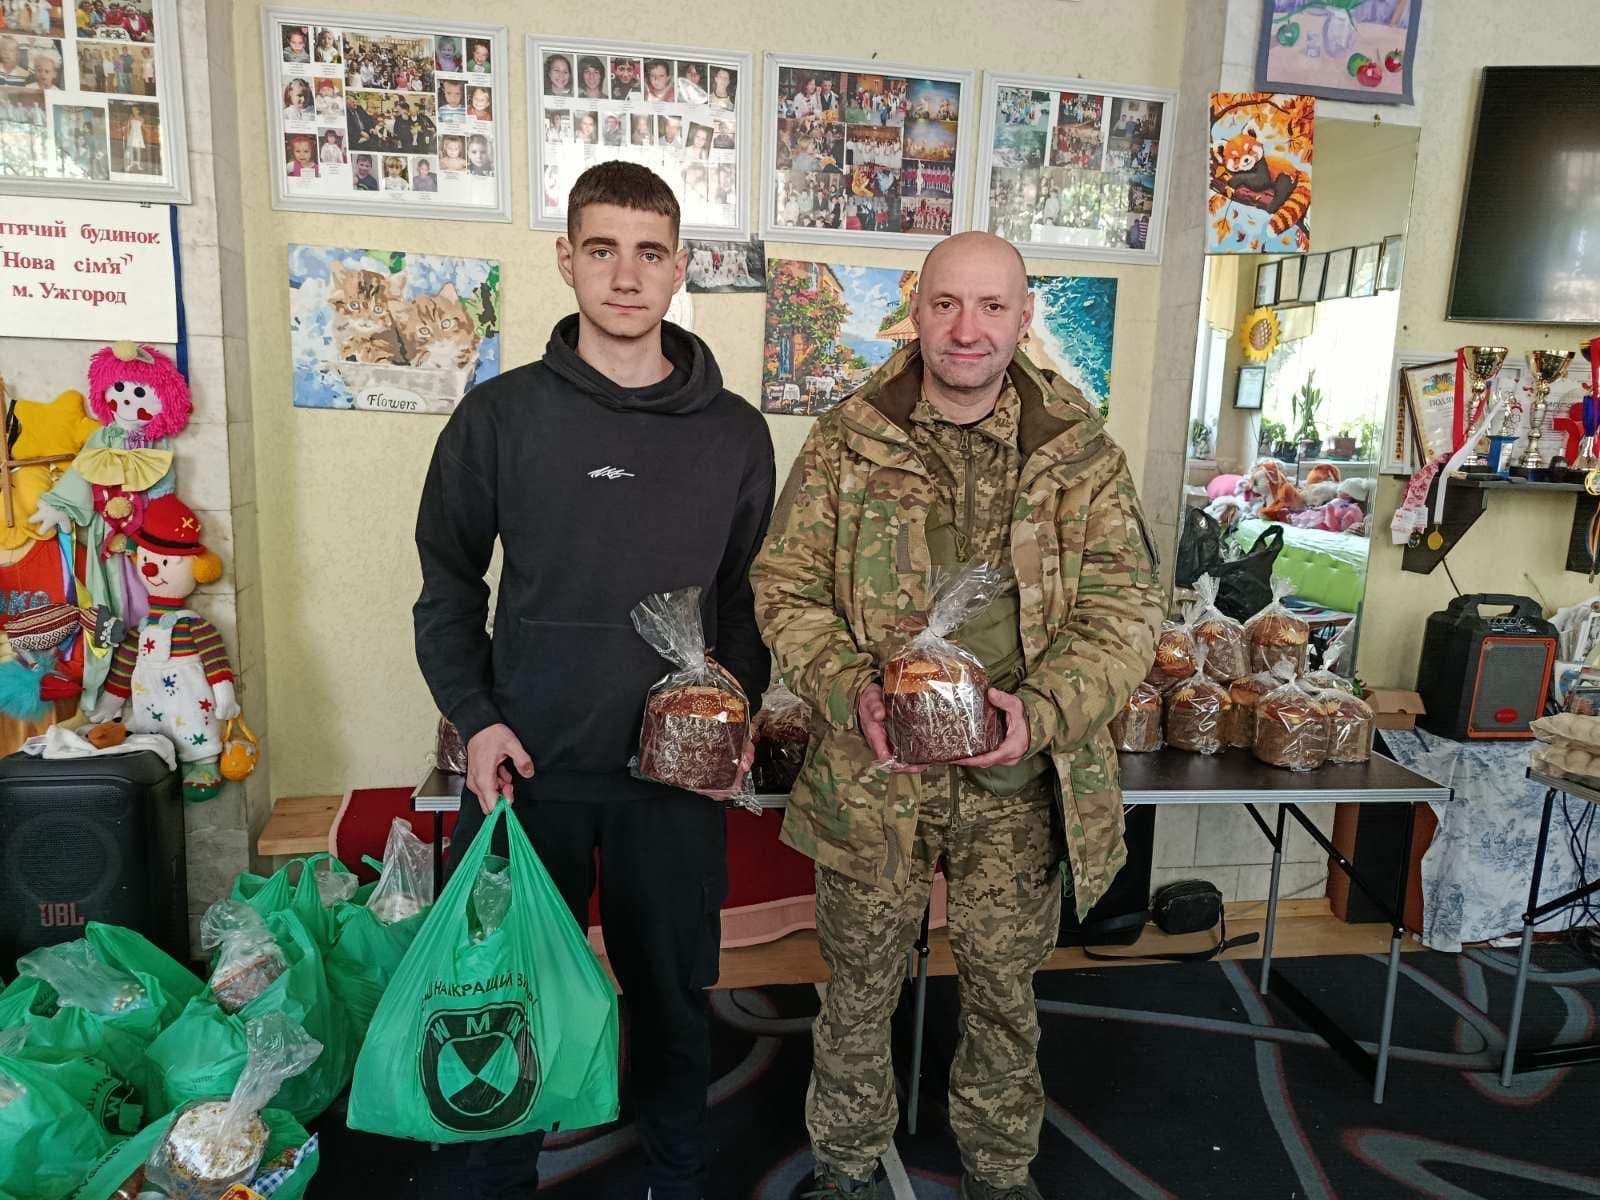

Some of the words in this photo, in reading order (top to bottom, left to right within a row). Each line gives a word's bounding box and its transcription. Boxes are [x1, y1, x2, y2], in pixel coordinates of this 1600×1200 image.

[80, 223, 160, 244] будинок
[3, 251, 56, 271] Нова
[12, 284, 33, 298] м.
[39, 282, 127, 306] Ужгород
[367, 393, 417, 410] Flowers
[39, 902, 85, 928] JBL
